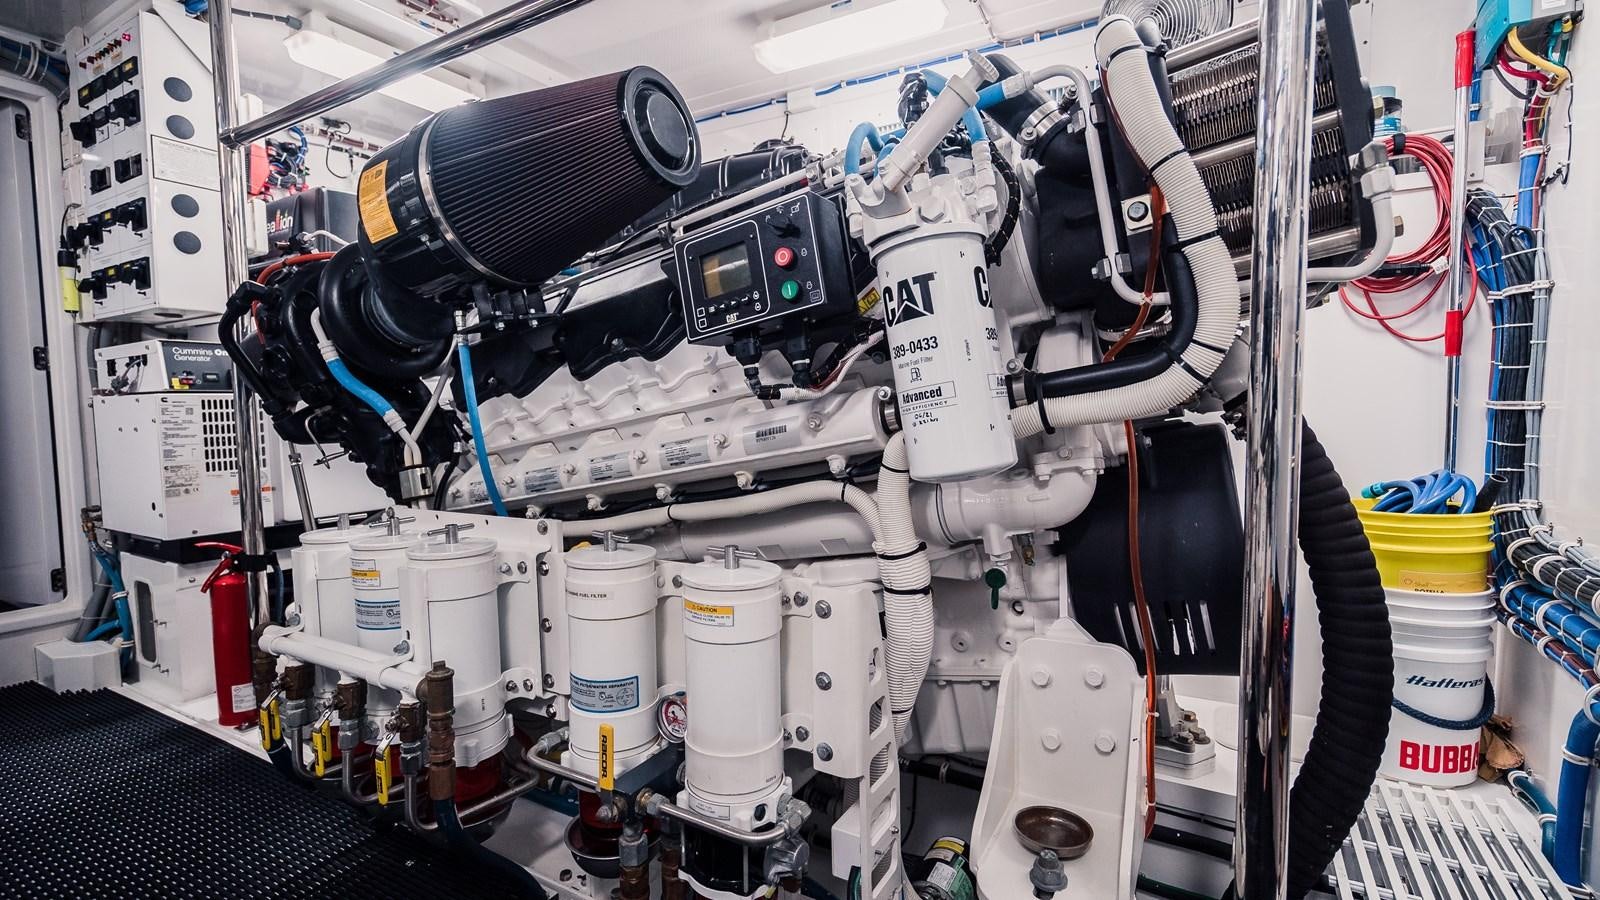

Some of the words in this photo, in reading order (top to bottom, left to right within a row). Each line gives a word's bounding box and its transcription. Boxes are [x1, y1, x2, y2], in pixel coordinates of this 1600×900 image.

[883, 272, 935, 327] CAT
[726, 313, 737, 323] CAT
[172, 346, 213, 356] Cummins
[893, 336, 938, 359] 389-0433
[902, 386, 942, 404] Advanced
[912, 400, 948, 411] EFFICIENCY
